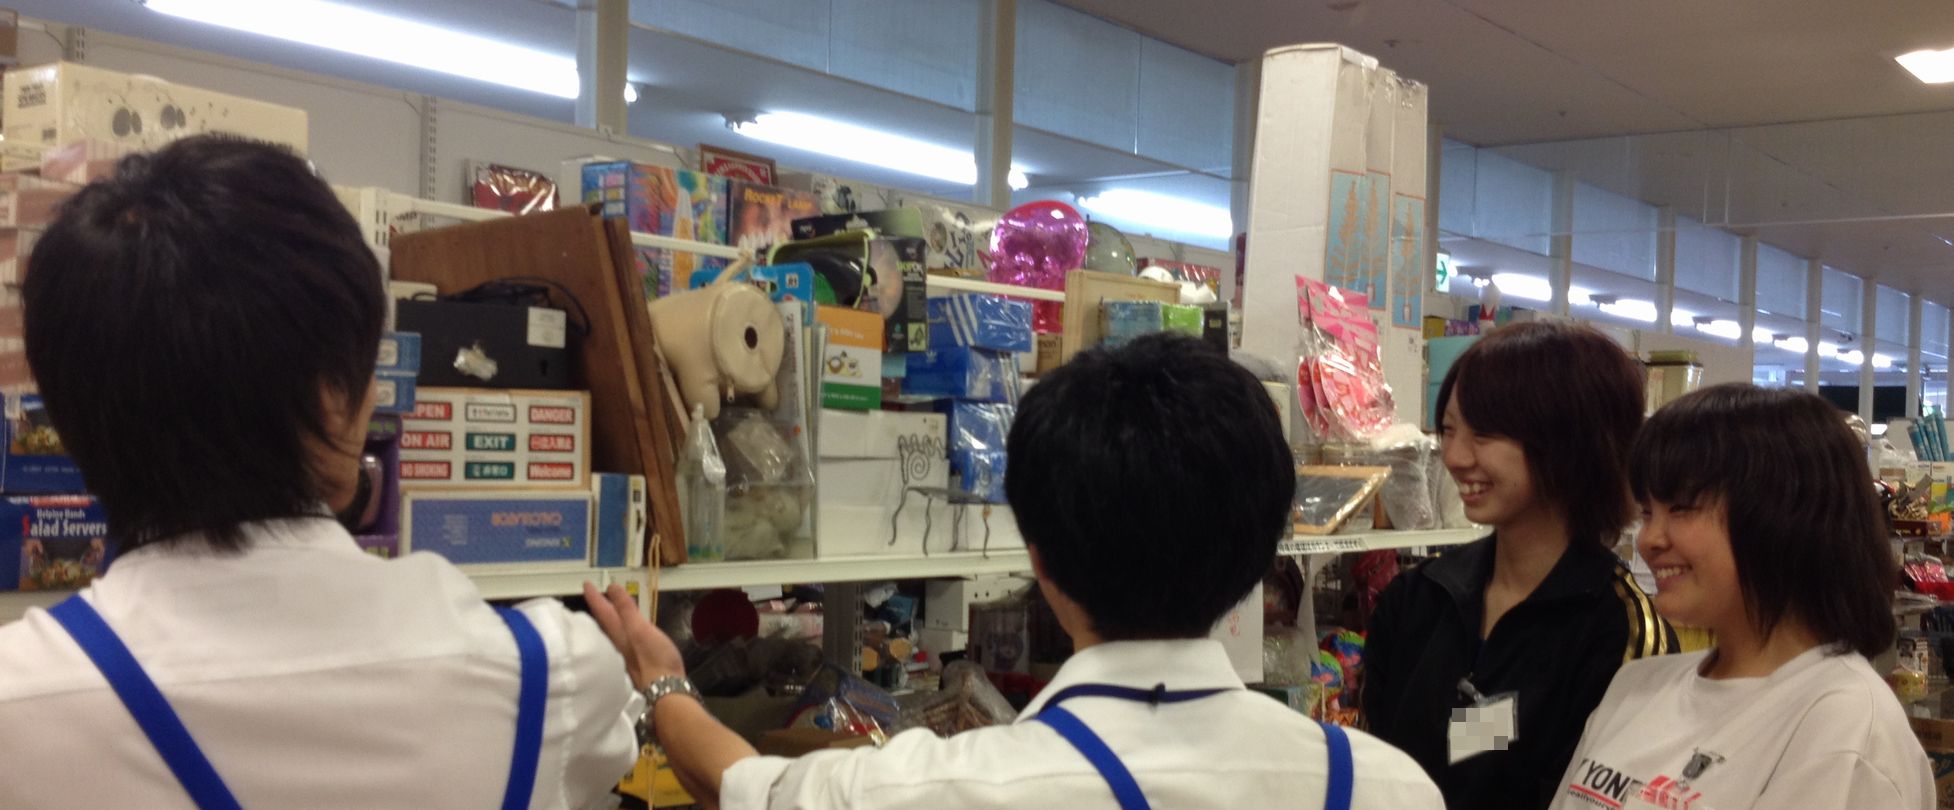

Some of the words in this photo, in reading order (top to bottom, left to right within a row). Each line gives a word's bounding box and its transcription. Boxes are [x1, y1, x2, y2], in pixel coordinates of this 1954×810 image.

[408, 403, 445, 418] PEN
[531, 408, 573, 422] DANGER
[401, 433, 422, 448] ON
[425, 433, 450, 448] AIR
[473, 435, 509, 449] EXIT
[529, 463, 571, 478] Welcome
[37, 508, 63, 520] Helping
[65, 509, 85, 519] Hands
[63, 518, 107, 537] Servers
